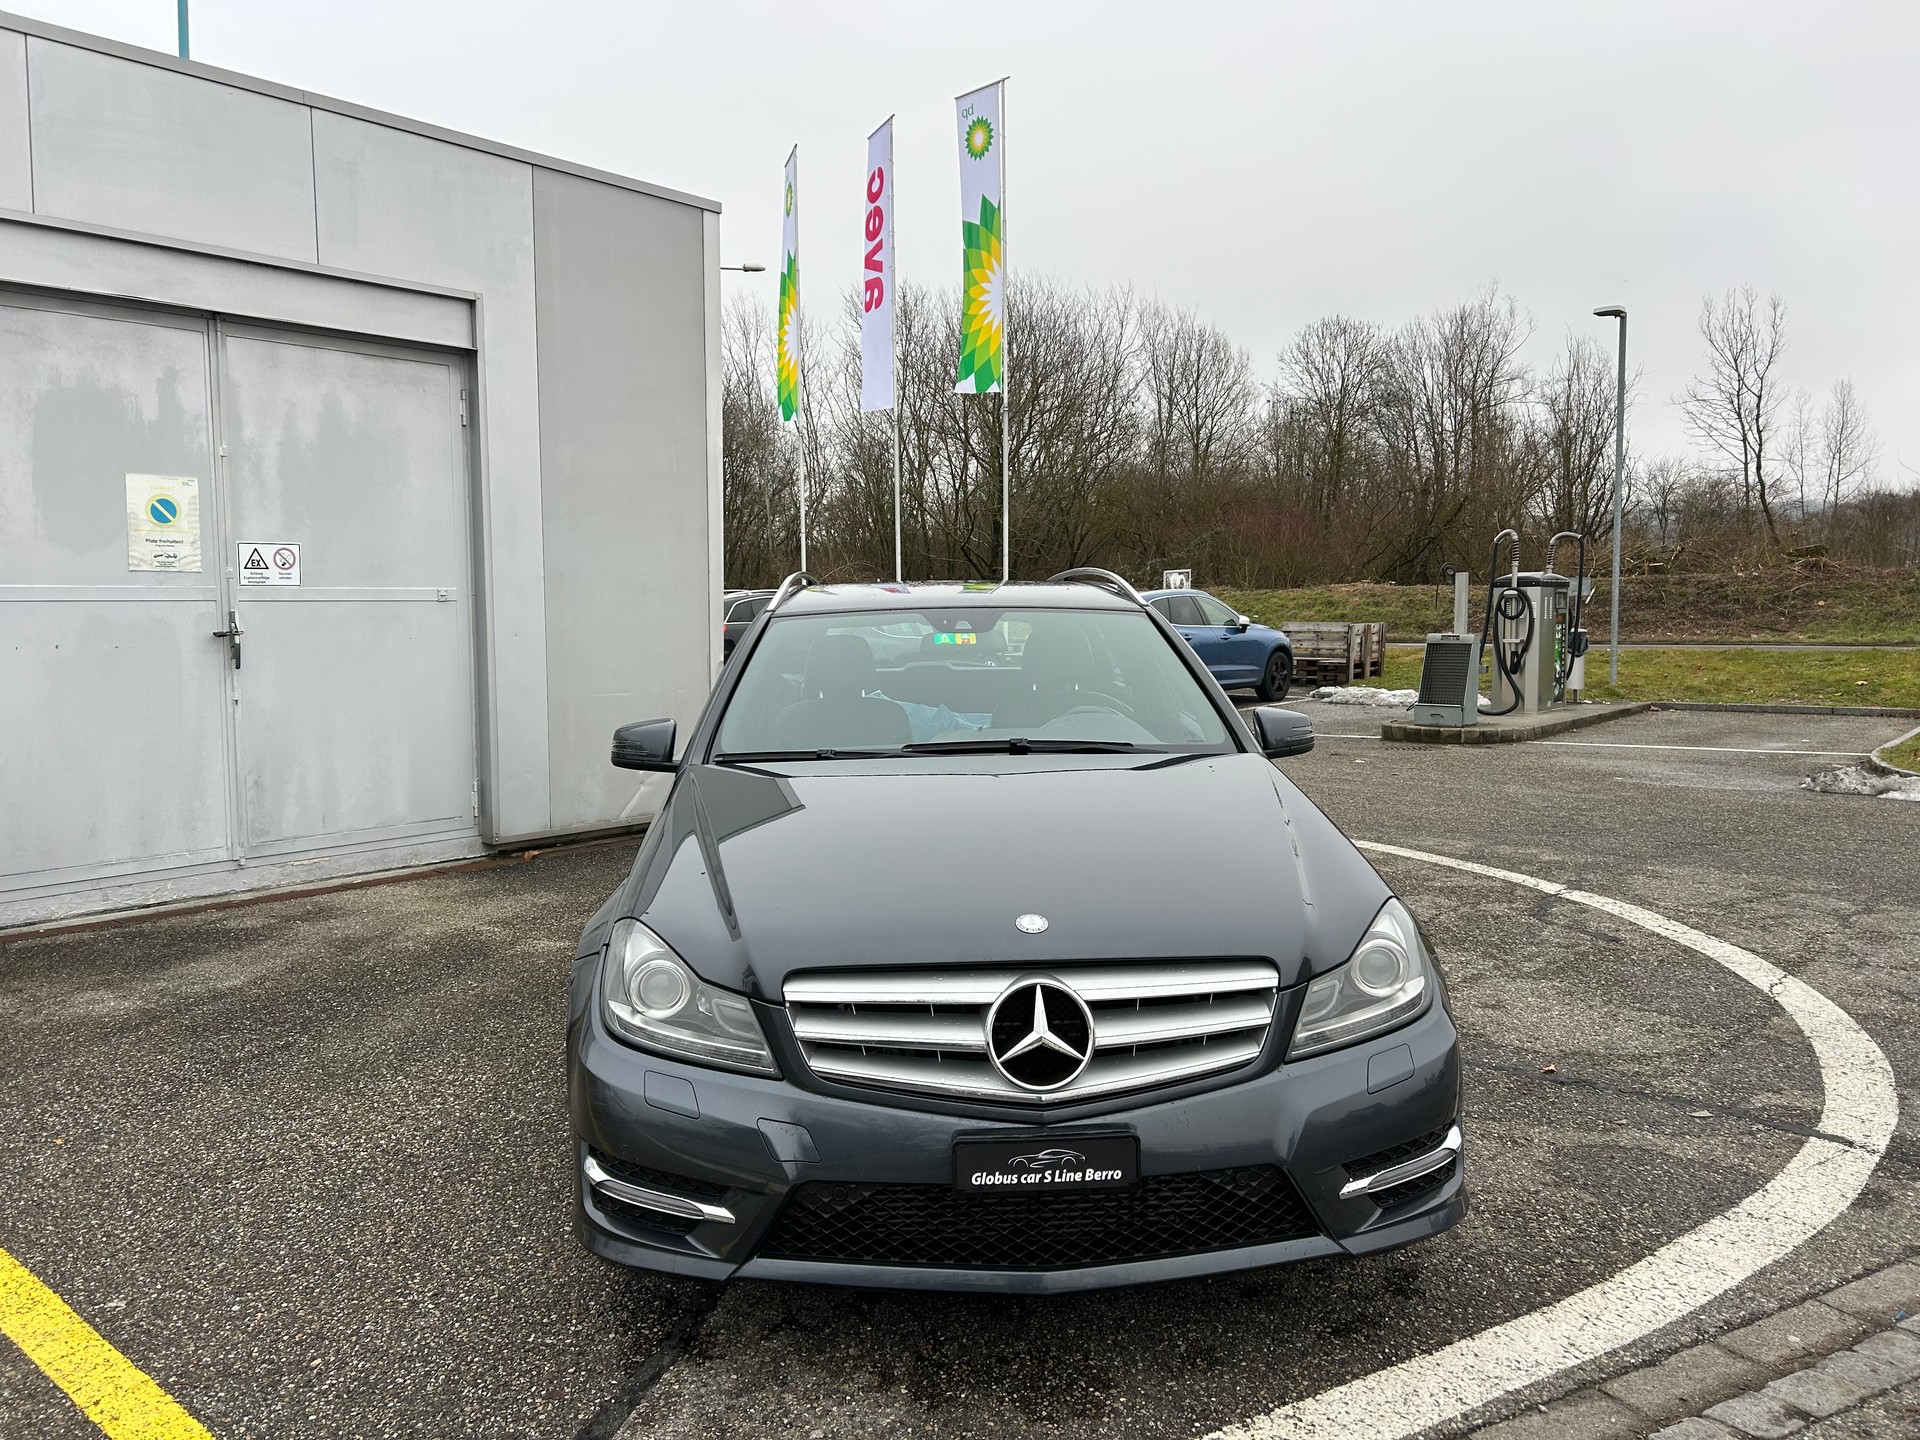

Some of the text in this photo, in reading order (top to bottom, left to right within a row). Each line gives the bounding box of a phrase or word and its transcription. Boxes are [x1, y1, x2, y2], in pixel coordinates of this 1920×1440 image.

[251, 559, 262, 567] EX
[971, 1168, 1122, 1186] Globus car S Line Berro
